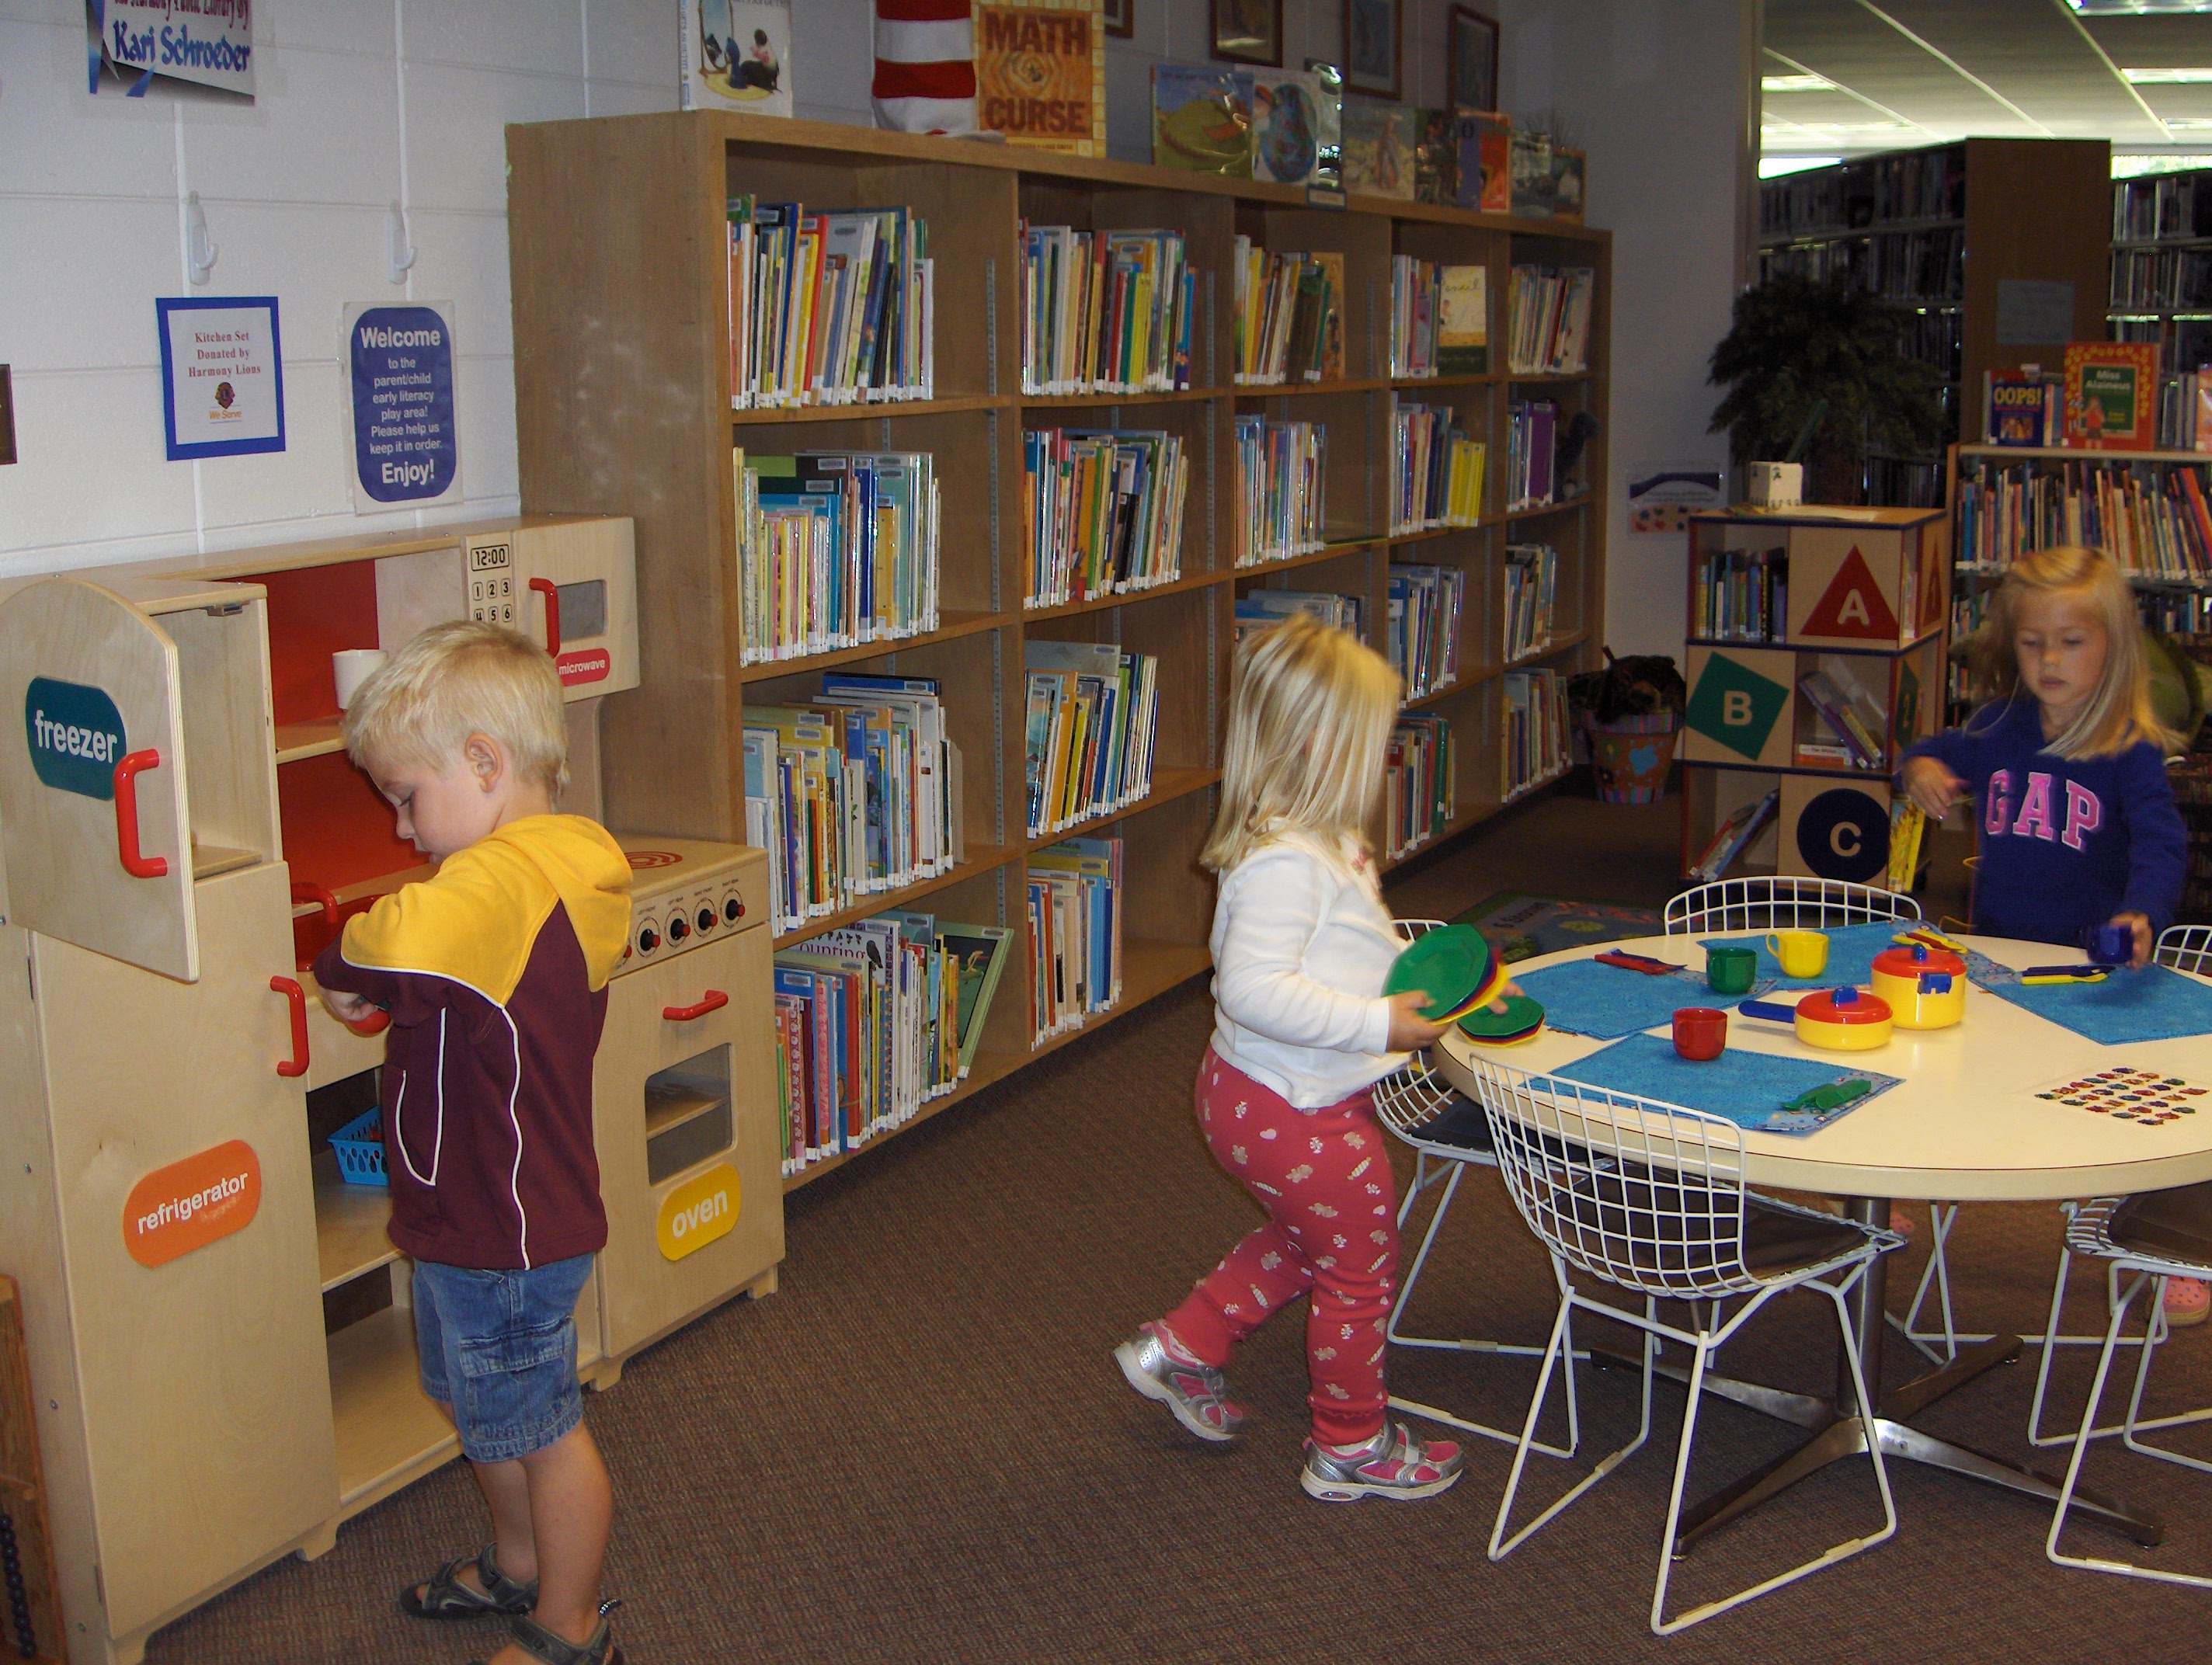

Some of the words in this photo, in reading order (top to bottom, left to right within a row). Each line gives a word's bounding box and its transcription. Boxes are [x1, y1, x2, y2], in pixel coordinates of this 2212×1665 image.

[985, 12, 1087, 55] MATH
[113, 19, 155, 63] Kari
[160, 24, 251, 71] Schroeder
[984, 96, 1087, 134] CURSE
[194, 332, 232, 343] Kitchen
[235, 331, 249, 341] Set
[360, 325, 441, 349] Welcome
[197, 347, 236, 360] Donated
[238, 347, 249, 360] by
[388, 358, 398, 369] to
[400, 357, 416, 369] the
[188, 367, 232, 378] Harmony
[235, 364, 261, 374] Lions
[374, 372, 431, 389] parent/child
[373, 391, 397, 405] early
[399, 390, 434, 403] literacy
[1993, 385, 2042, 405] OOPS!
[209, 411, 220, 419] We
[221, 410, 242, 419] Serve
[381, 408, 402, 422] play
[403, 405, 428, 418] area!
[370, 425, 404, 437] Please
[405, 422, 426, 436] help
[428, 423, 440, 433] us
[369, 443, 394, 455] keep
[395, 440, 403, 452] it
[404, 440, 412, 451] in
[415, 438, 443, 450] order.
[381, 457, 435, 487] Enjoy!
[475, 547, 506, 566] 12:00
[489, 583, 495, 596] 2
[503, 582, 509, 593] 3
[491, 609, 496, 621] 5
[504, 607, 510, 619] 6
[1836, 588, 1870, 627] A
[558, 659, 606, 676] microwave
[1723, 690, 1753, 726] B
[34, 709, 118, 763] freezer
[1985, 768, 2102, 850] GAP
[1829, 821, 1862, 857] C
[137, 1172, 249, 1235] refrigerator
[672, 1189, 728, 1239] oven
